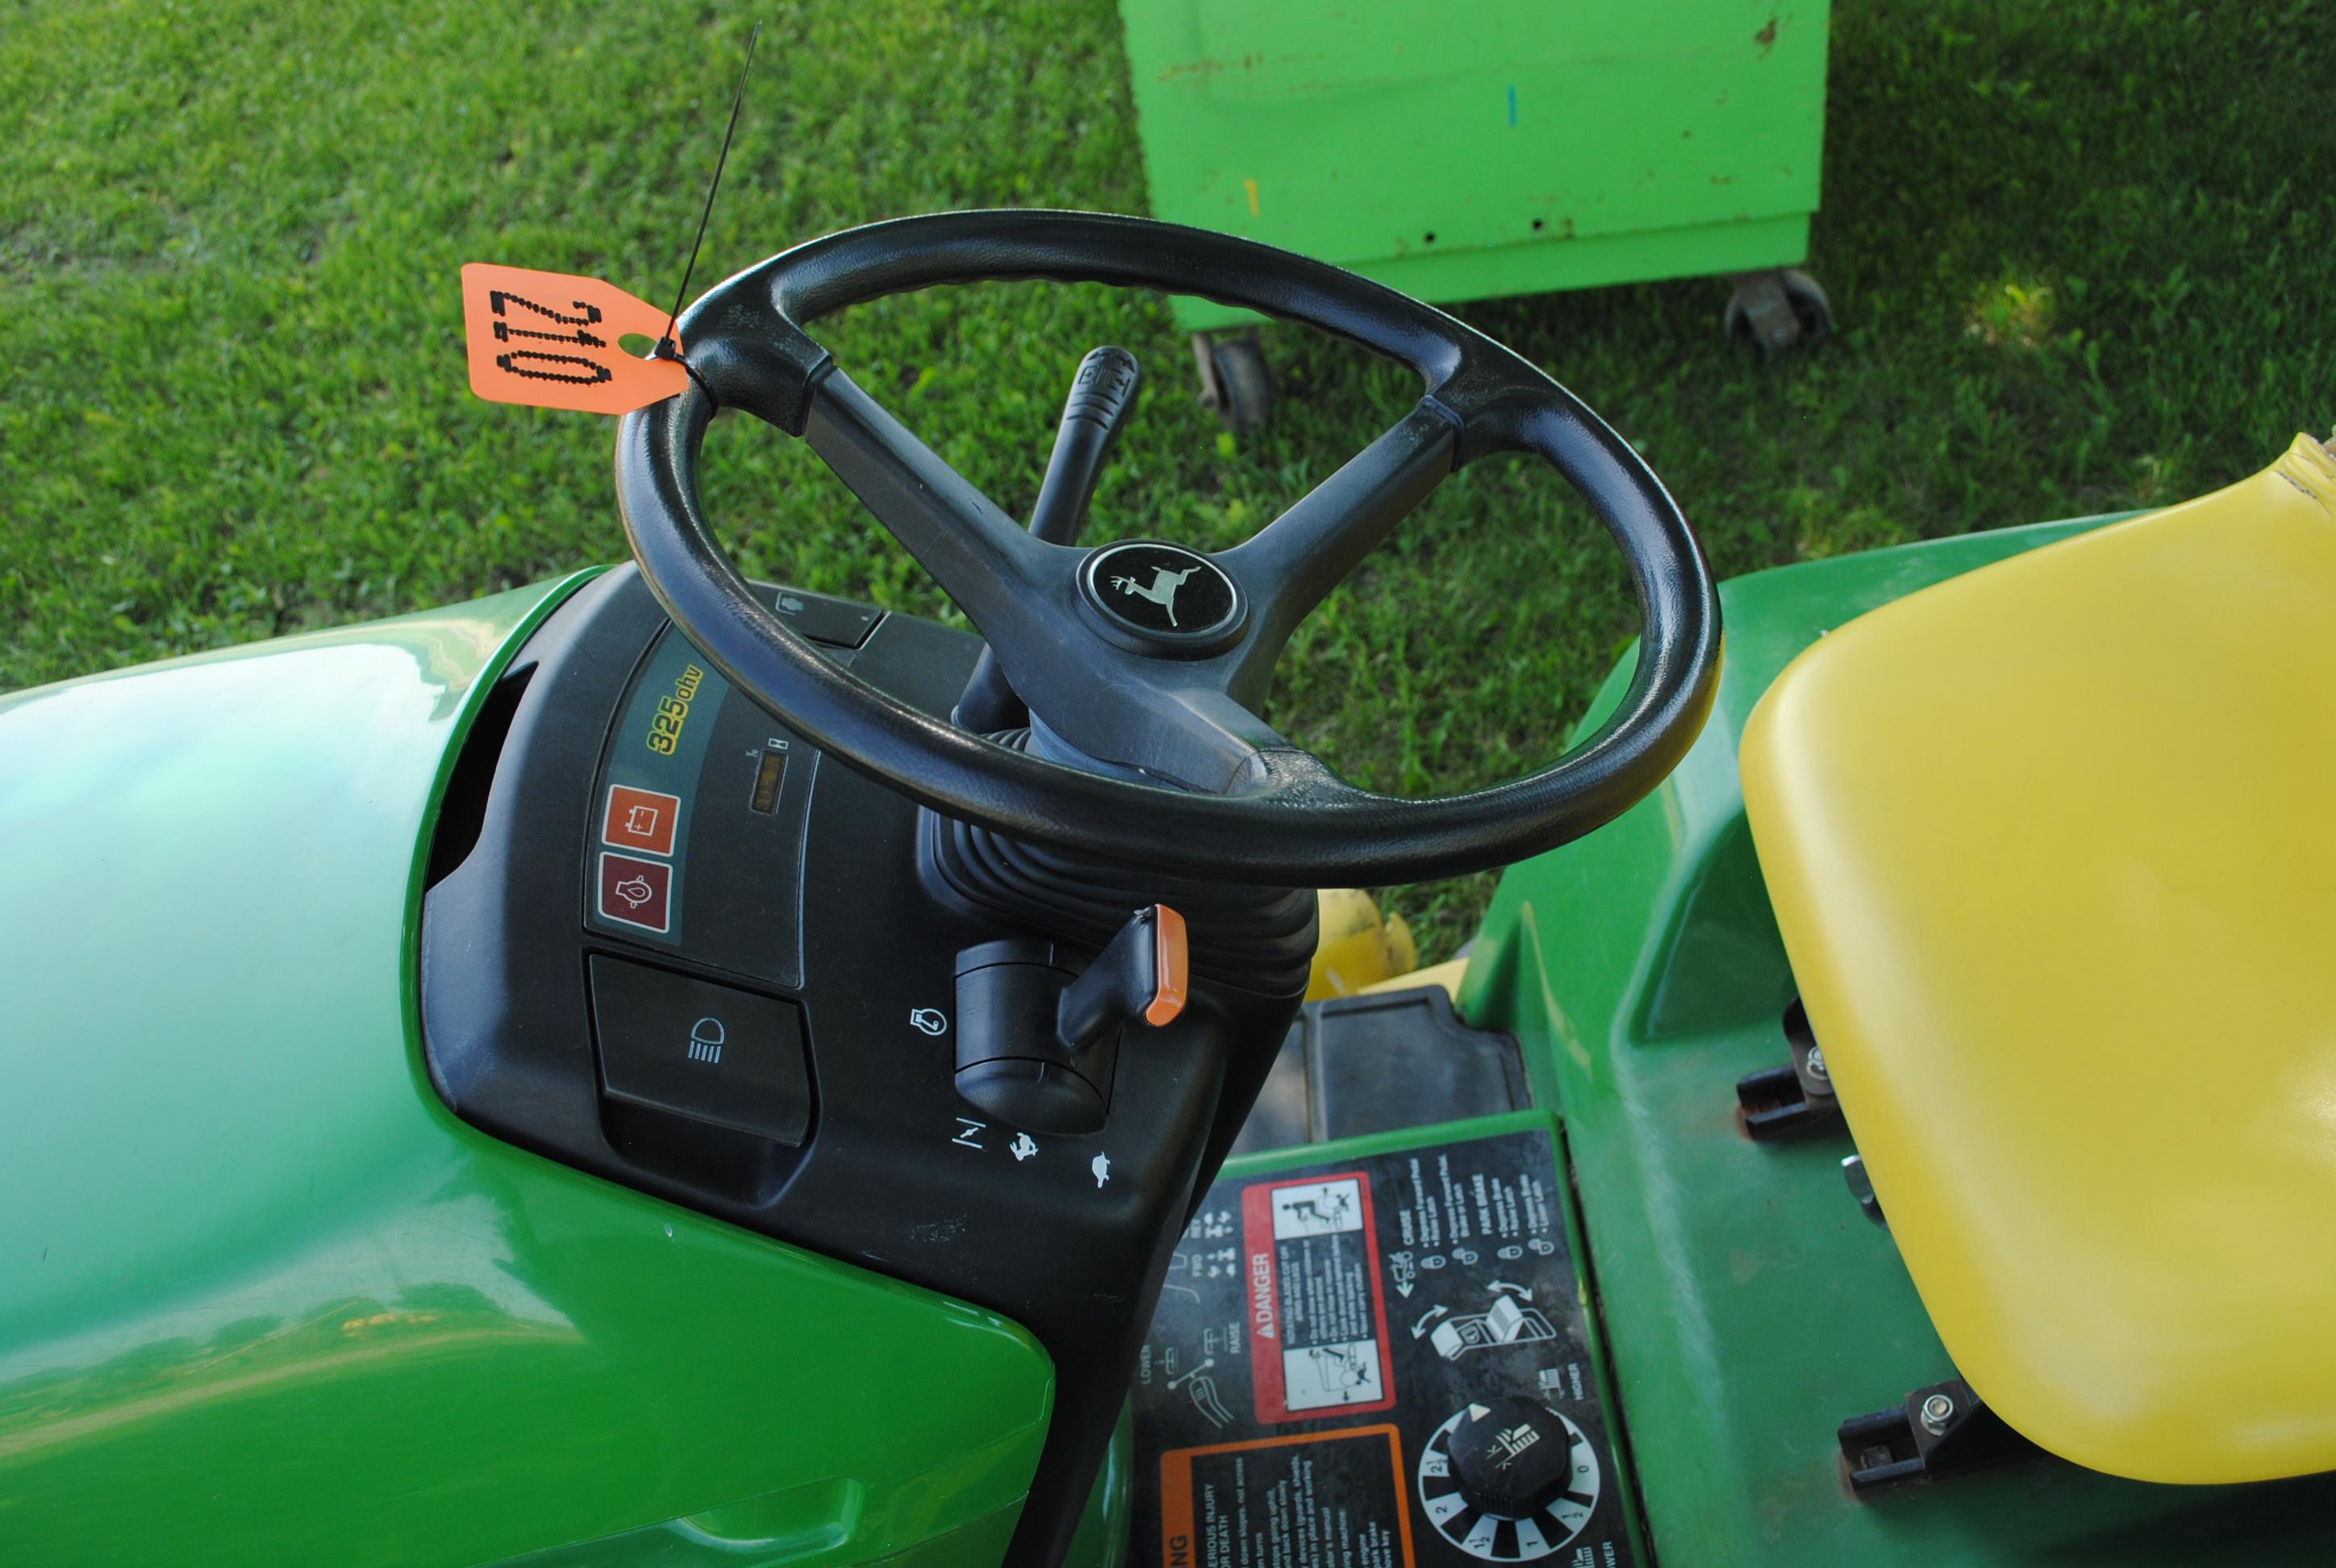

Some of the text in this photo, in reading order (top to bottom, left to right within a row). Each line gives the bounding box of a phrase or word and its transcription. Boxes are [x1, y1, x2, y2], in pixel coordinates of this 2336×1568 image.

[489, 290, 612, 386] 210
[1413, 1179, 1425, 1210] Forward
[1441, 1176, 1454, 1207] Forward
[1454, 1183, 1464, 1204] Latch
[1473, 1174, 1492, 1235] PARK BRAKE
[1491, 1178, 1508, 1232] Depress Brake
[1504, 1186, 1515, 1207] Latch
[1520, 1174, 1537, 1228] Depress Brake
[1533, 1180, 1544, 1202] Latch
[1399, 1209, 1415, 1245] CRUISE
[1417, 1211, 1430, 1242] Depress
[1427, 1196, 1441, 1241] Raise Latch
[1447, 1207, 1459, 1238] Depress
[1459, 1215, 1470, 1237] Brake
[1192, 1254, 1203, 1277] FWD
[1252, 1253, 1274, 1323] DANGER
[1228, 1320, 1241, 1353] RAISE
[1234, 1457, 1245, 1486] across
[1302, 1460, 1315, 1495] working
[1203, 1483, 1216, 1522] INJURY
[1236, 1488, 1245, 1503] not
[1278, 1479, 1289, 1505] slowly
[1305, 1497, 1315, 1514] and
[1279, 1508, 1289, 1530] down
[1320, 1506, 1333, 1540] manual
[1436, 1505, 1447, 1514] 2
[1217, 1515, 1230, 1553] DEATH
[1269, 1516, 1280, 1543] going
[1280, 1533, 1291, 1553] back
[1308, 1516, 1319, 1541] place
[1367, 1520, 1379, 1547] brake
[1379, 1529, 1391, 1546] key
[1239, 1539, 1249, 1564] down
[1254, 1533, 1264, 1556] turns
[1296, 1528, 1307, 1562] devices
[1308, 1542, 1317, 1551] in
[1358, 1533, 1370, 1565] engine
